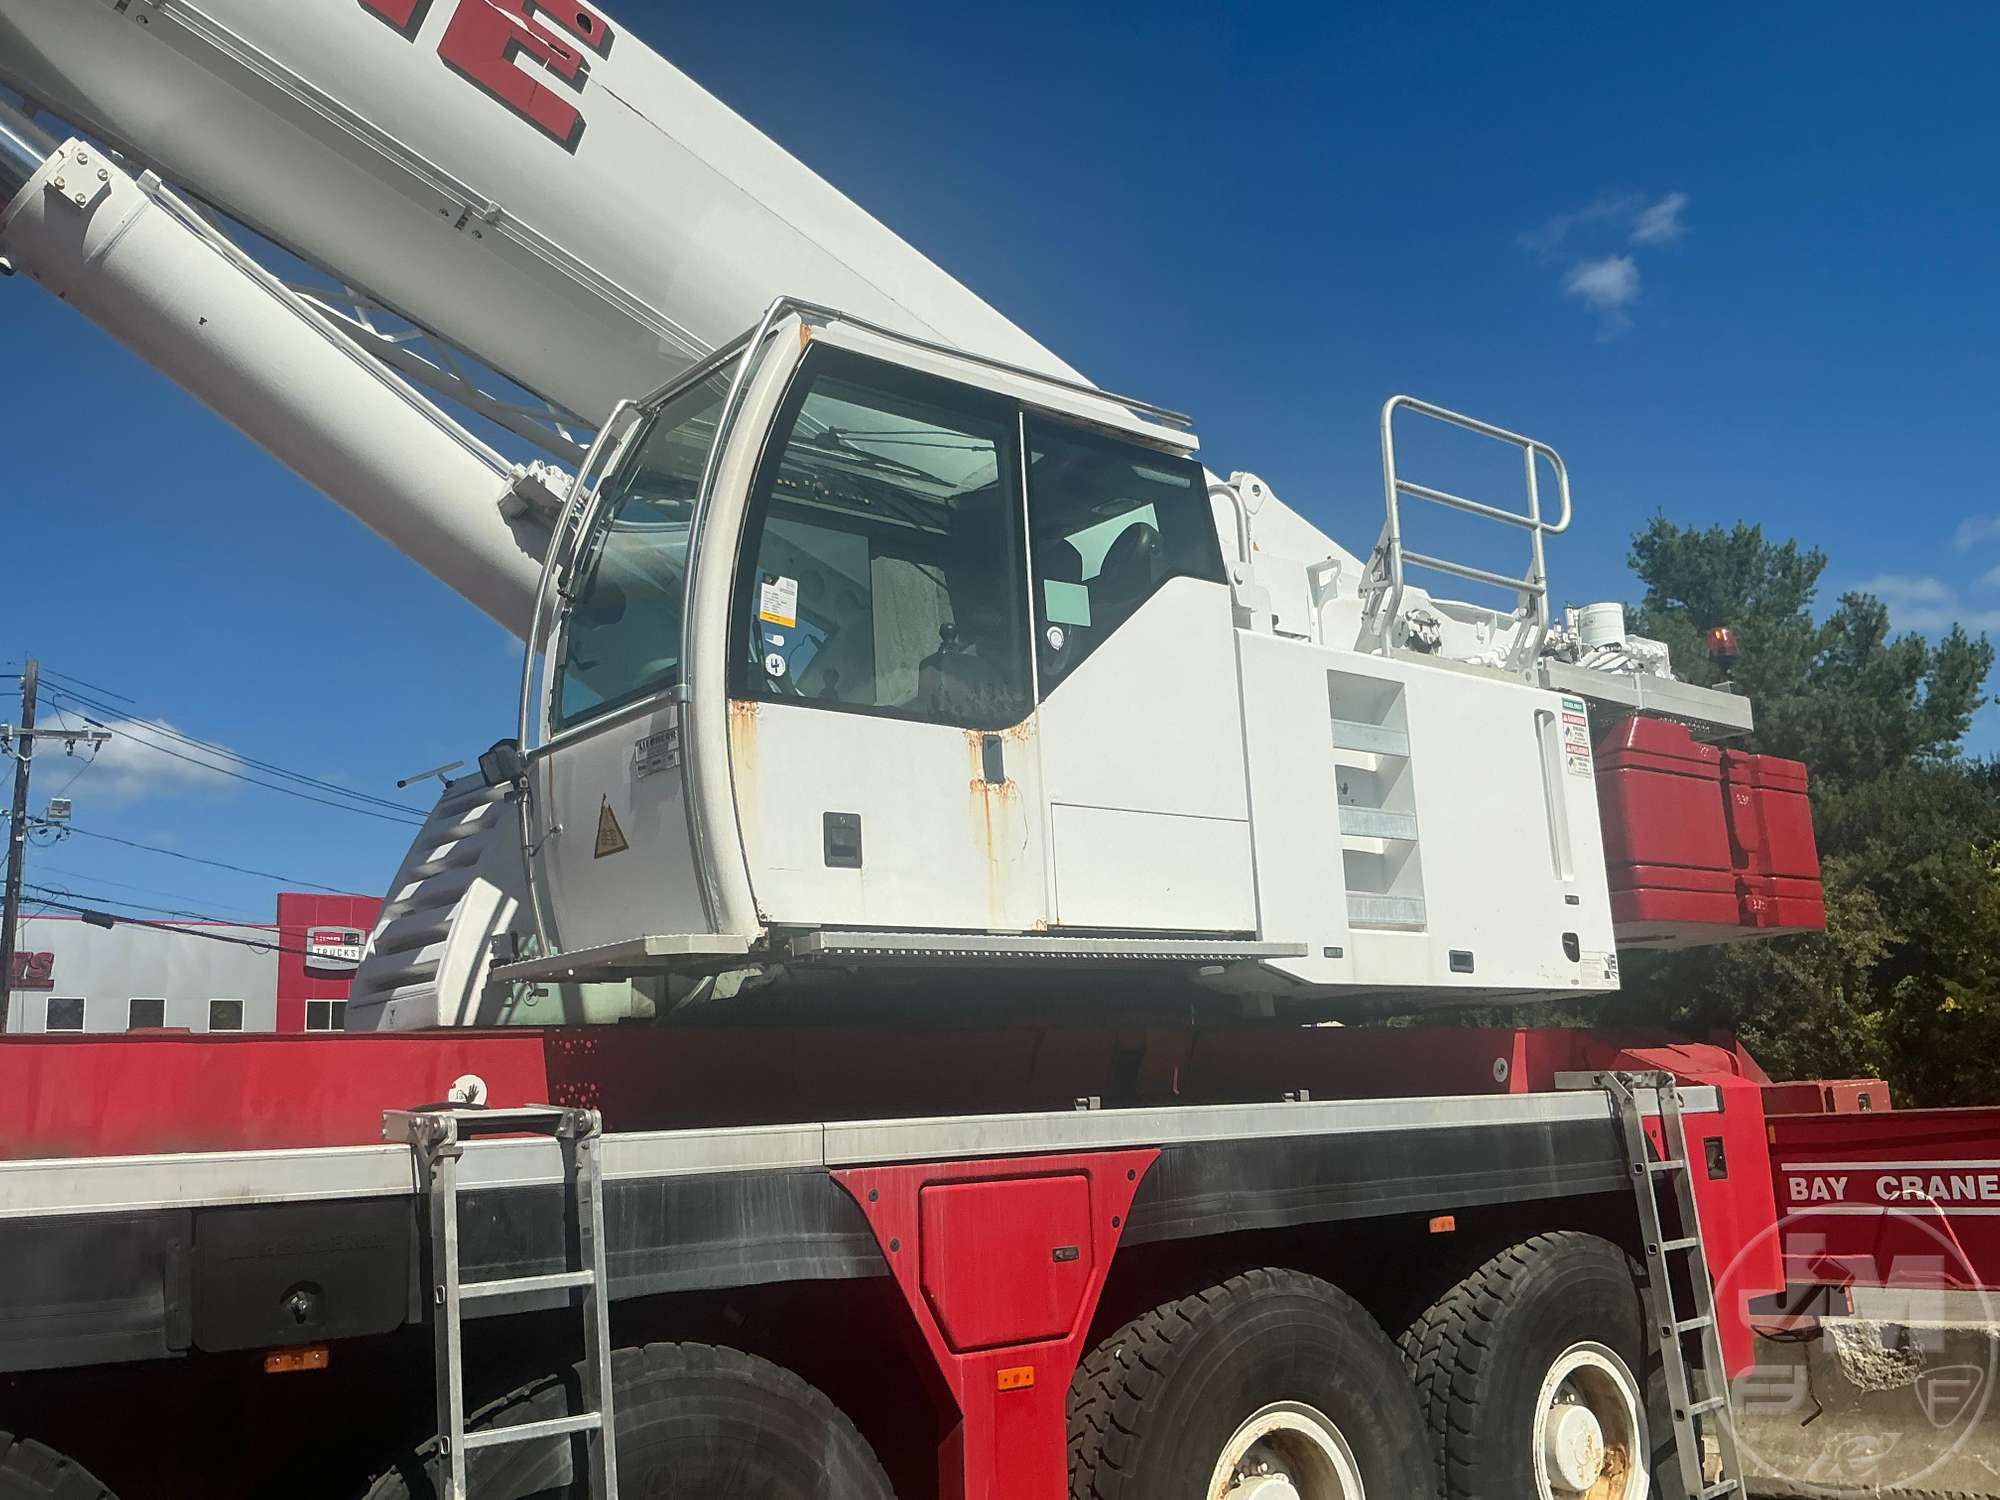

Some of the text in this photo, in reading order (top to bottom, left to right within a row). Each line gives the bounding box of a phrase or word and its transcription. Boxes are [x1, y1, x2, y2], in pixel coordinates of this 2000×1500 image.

[770, 657, 780, 674] 4
[316, 948, 357, 958] TRUCKS
[1789, 1175, 2000, 1201] BAY CRANE
